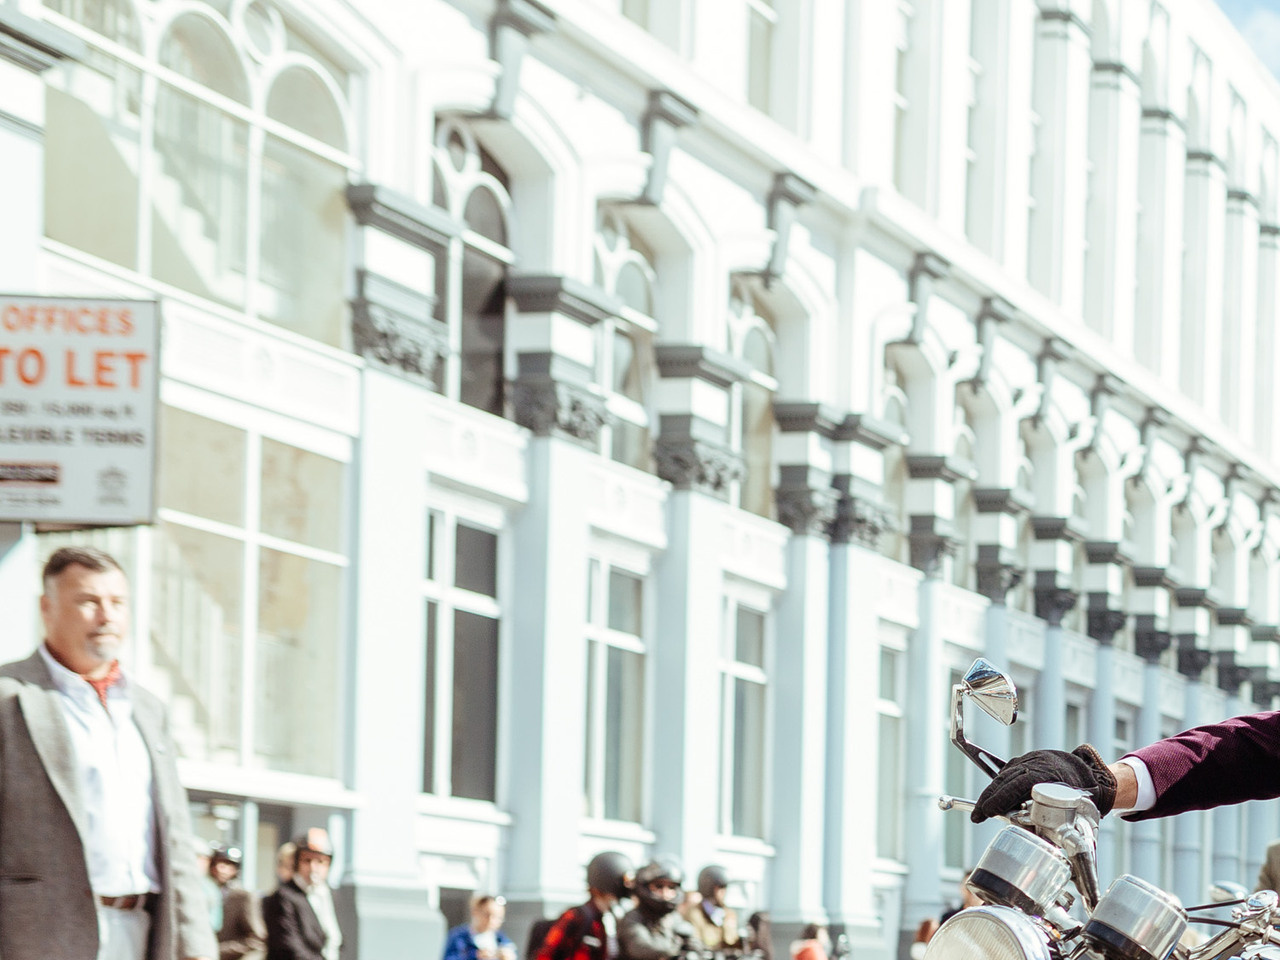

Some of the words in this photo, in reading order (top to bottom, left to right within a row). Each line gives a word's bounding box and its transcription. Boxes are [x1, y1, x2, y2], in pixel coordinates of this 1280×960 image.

[3, 305, 134, 336] OFFICES
[0, 348, 46, 387] TO
[65, 350, 147, 389] LET
